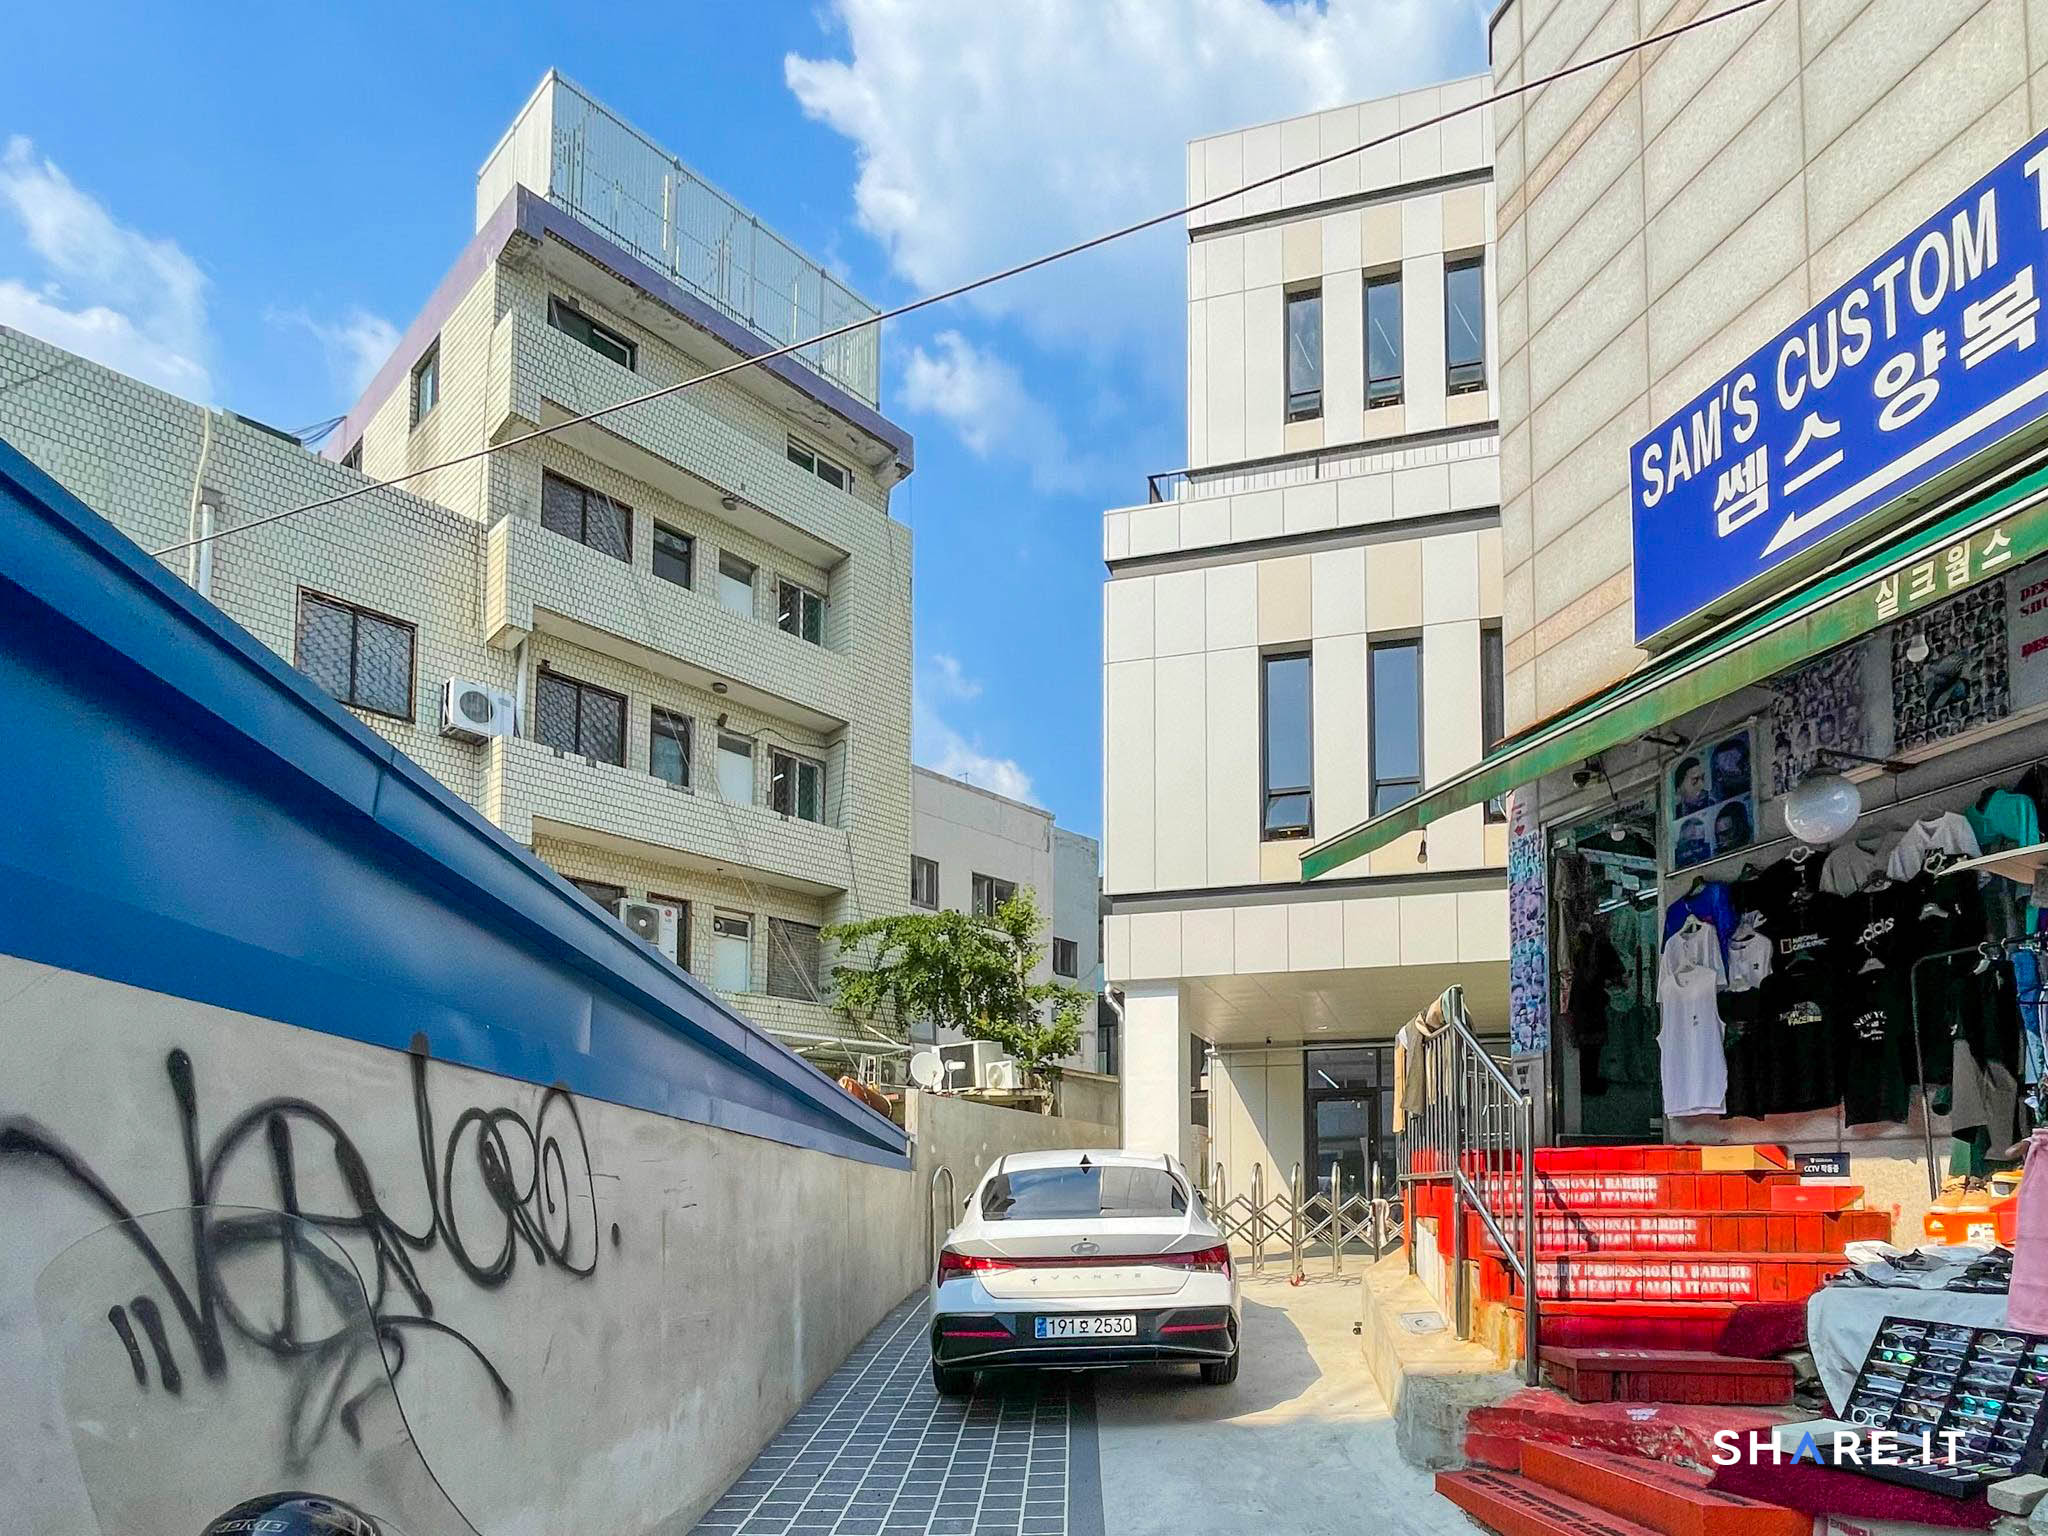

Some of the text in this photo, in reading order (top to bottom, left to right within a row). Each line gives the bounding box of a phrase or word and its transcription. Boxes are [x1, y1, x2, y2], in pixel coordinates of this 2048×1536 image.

[1641, 372, 1759, 509] SAM'S
[1776, 187, 1999, 412] CUSTOM
[1873, 264, 2041, 433] 양복
[1803, 1165, 1820, 1173] CCTV
[1584, 1264, 1688, 1278] PROFESSIONAL
[1690, 1265, 1751, 1279] BARBER
[1578, 1279, 1634, 1293] BEAUTY
[1636, 1279, 1682, 1294] SALON
[1684, 1280, 1751, 1295] ITAEWON
[1094, 1317, 1132, 1334] 2530
